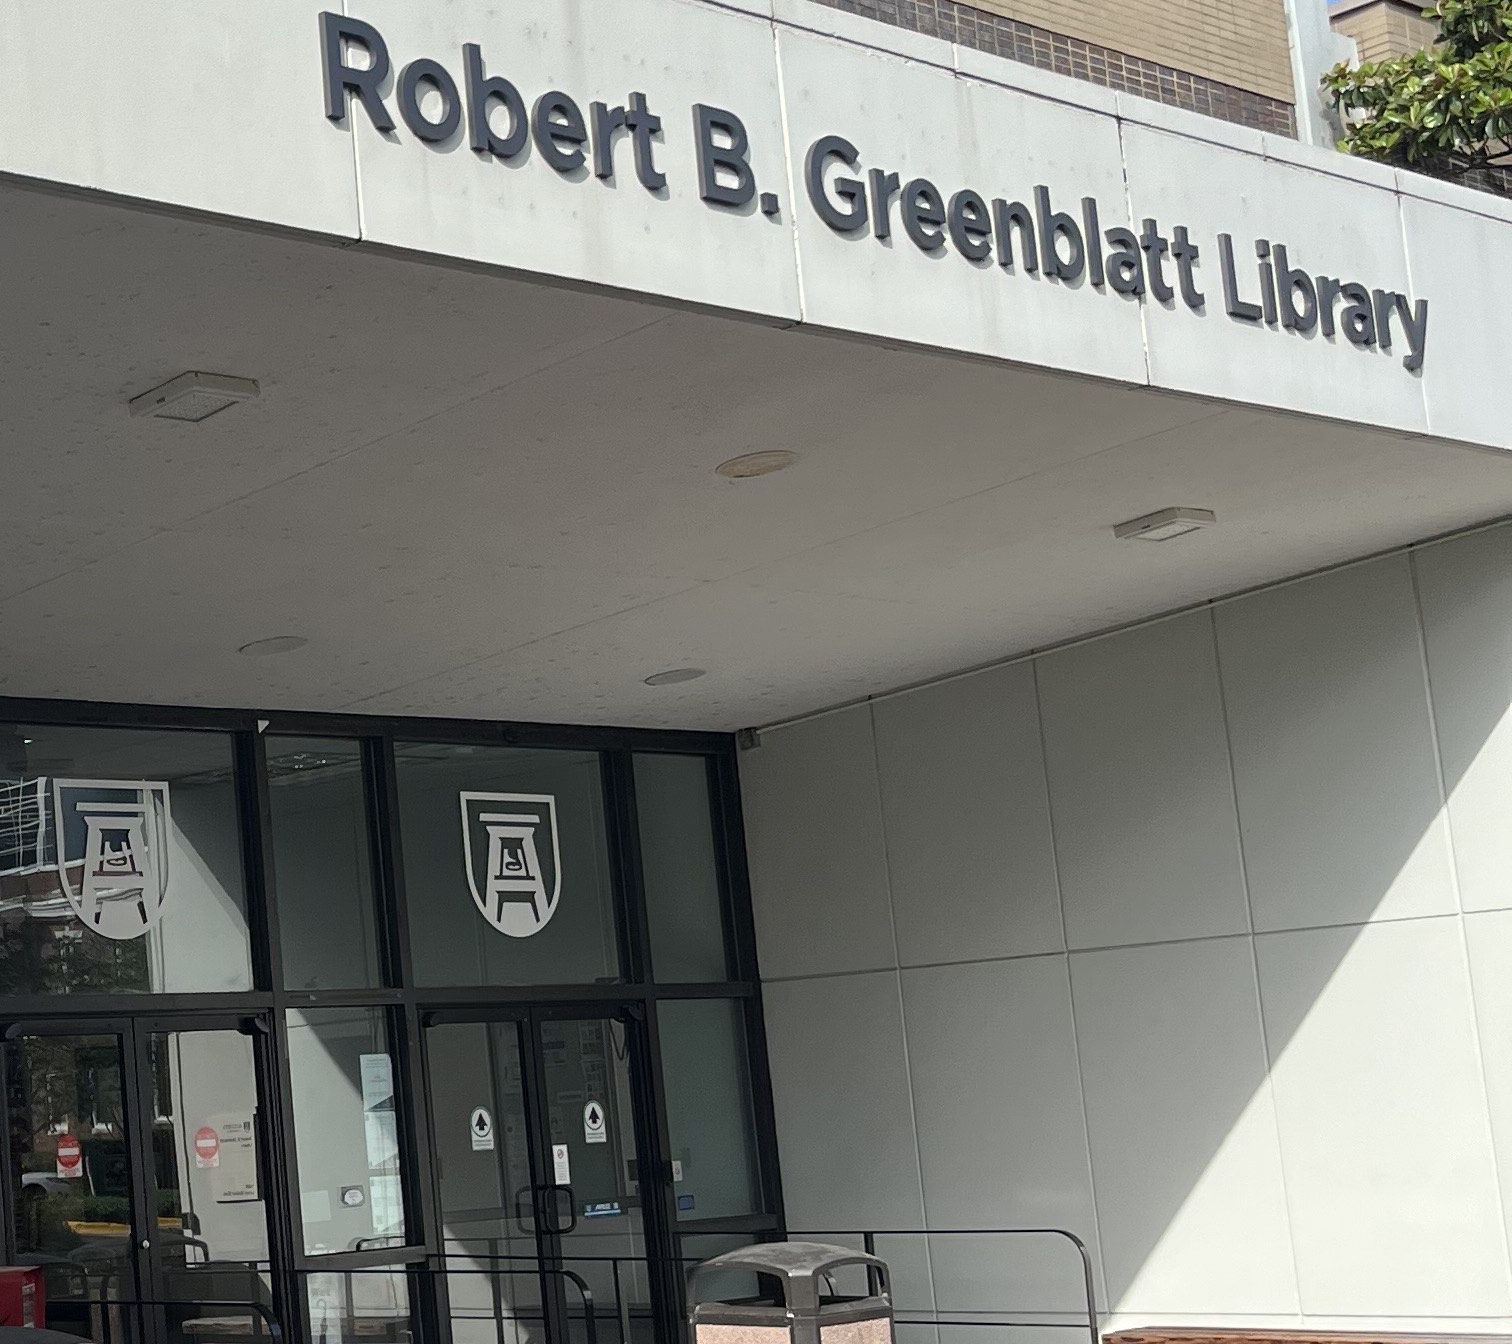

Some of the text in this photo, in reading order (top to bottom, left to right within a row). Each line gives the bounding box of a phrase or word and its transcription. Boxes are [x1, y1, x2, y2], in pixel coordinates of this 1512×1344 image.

[318, 11, 1429, 371] Robert B. Greenblatt Library
